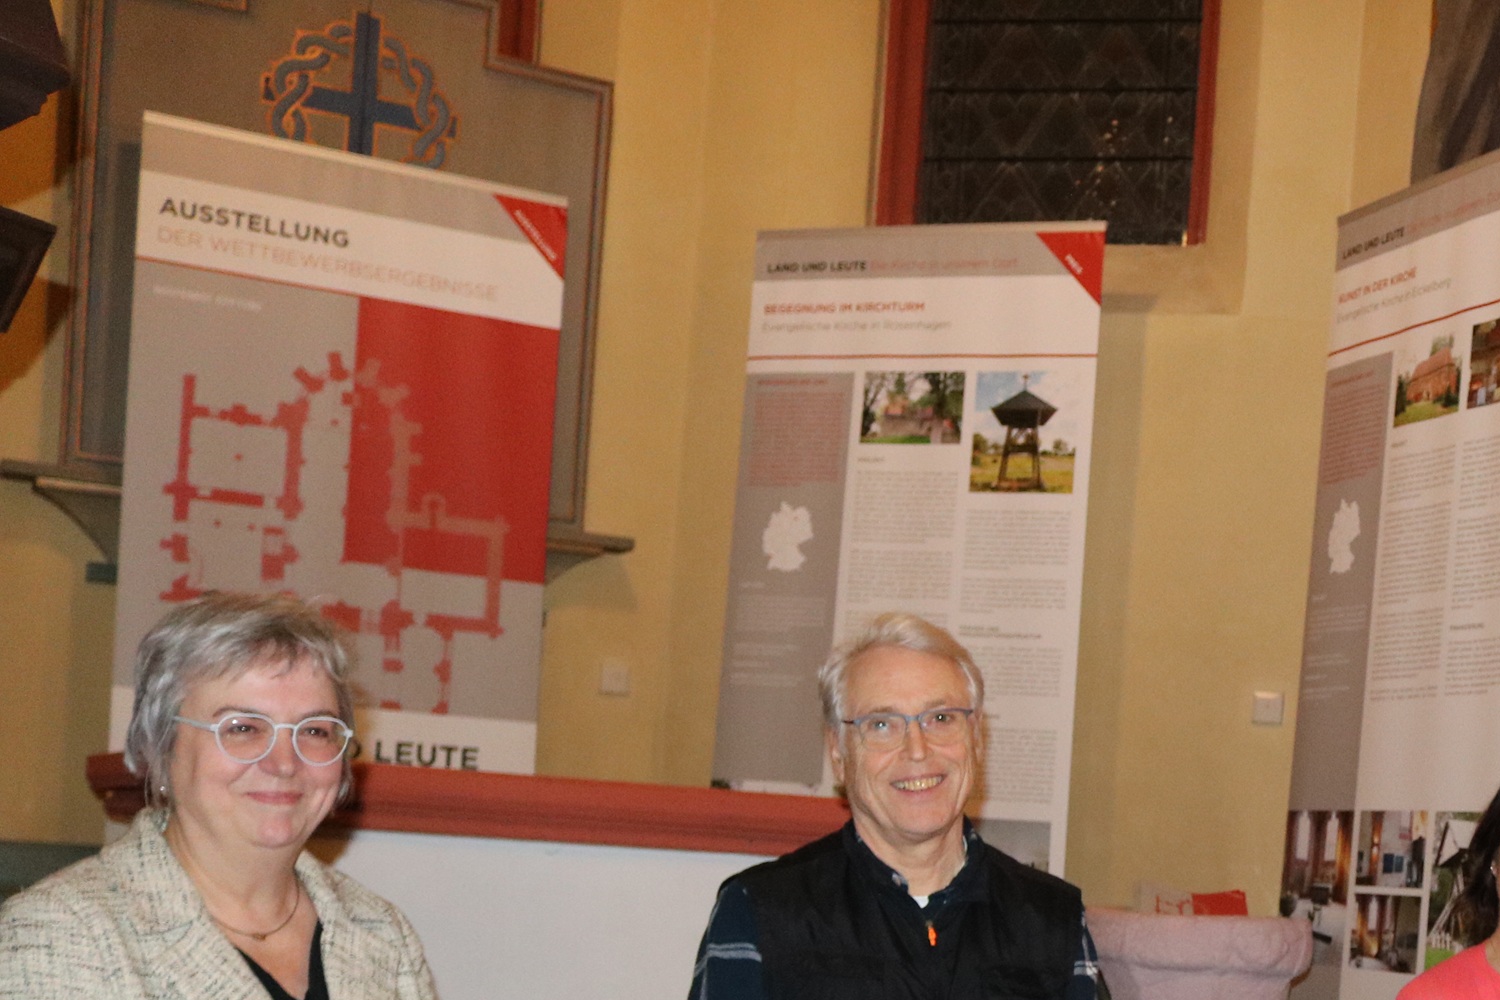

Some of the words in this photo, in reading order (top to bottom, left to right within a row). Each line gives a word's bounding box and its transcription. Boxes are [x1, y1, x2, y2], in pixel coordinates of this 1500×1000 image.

[160, 198, 349, 248] AUSSTELLUNG
[158, 225, 202, 249] DER
[1381, 226, 1405, 245] LEUTE
[767, 262, 799, 274] LAND
[801, 261, 828, 273] UND
[830, 260, 867, 272] LEUTE
[764, 303, 836, 315] BEGEGNUNG
[839, 302, 852, 313] IM
[855, 301, 925, 313] KIRCHTURM
[762, 321, 831, 334] Evangelische
[833, 321, 868, 332] Kirche
[375, 741, 479, 770] LEUTE
